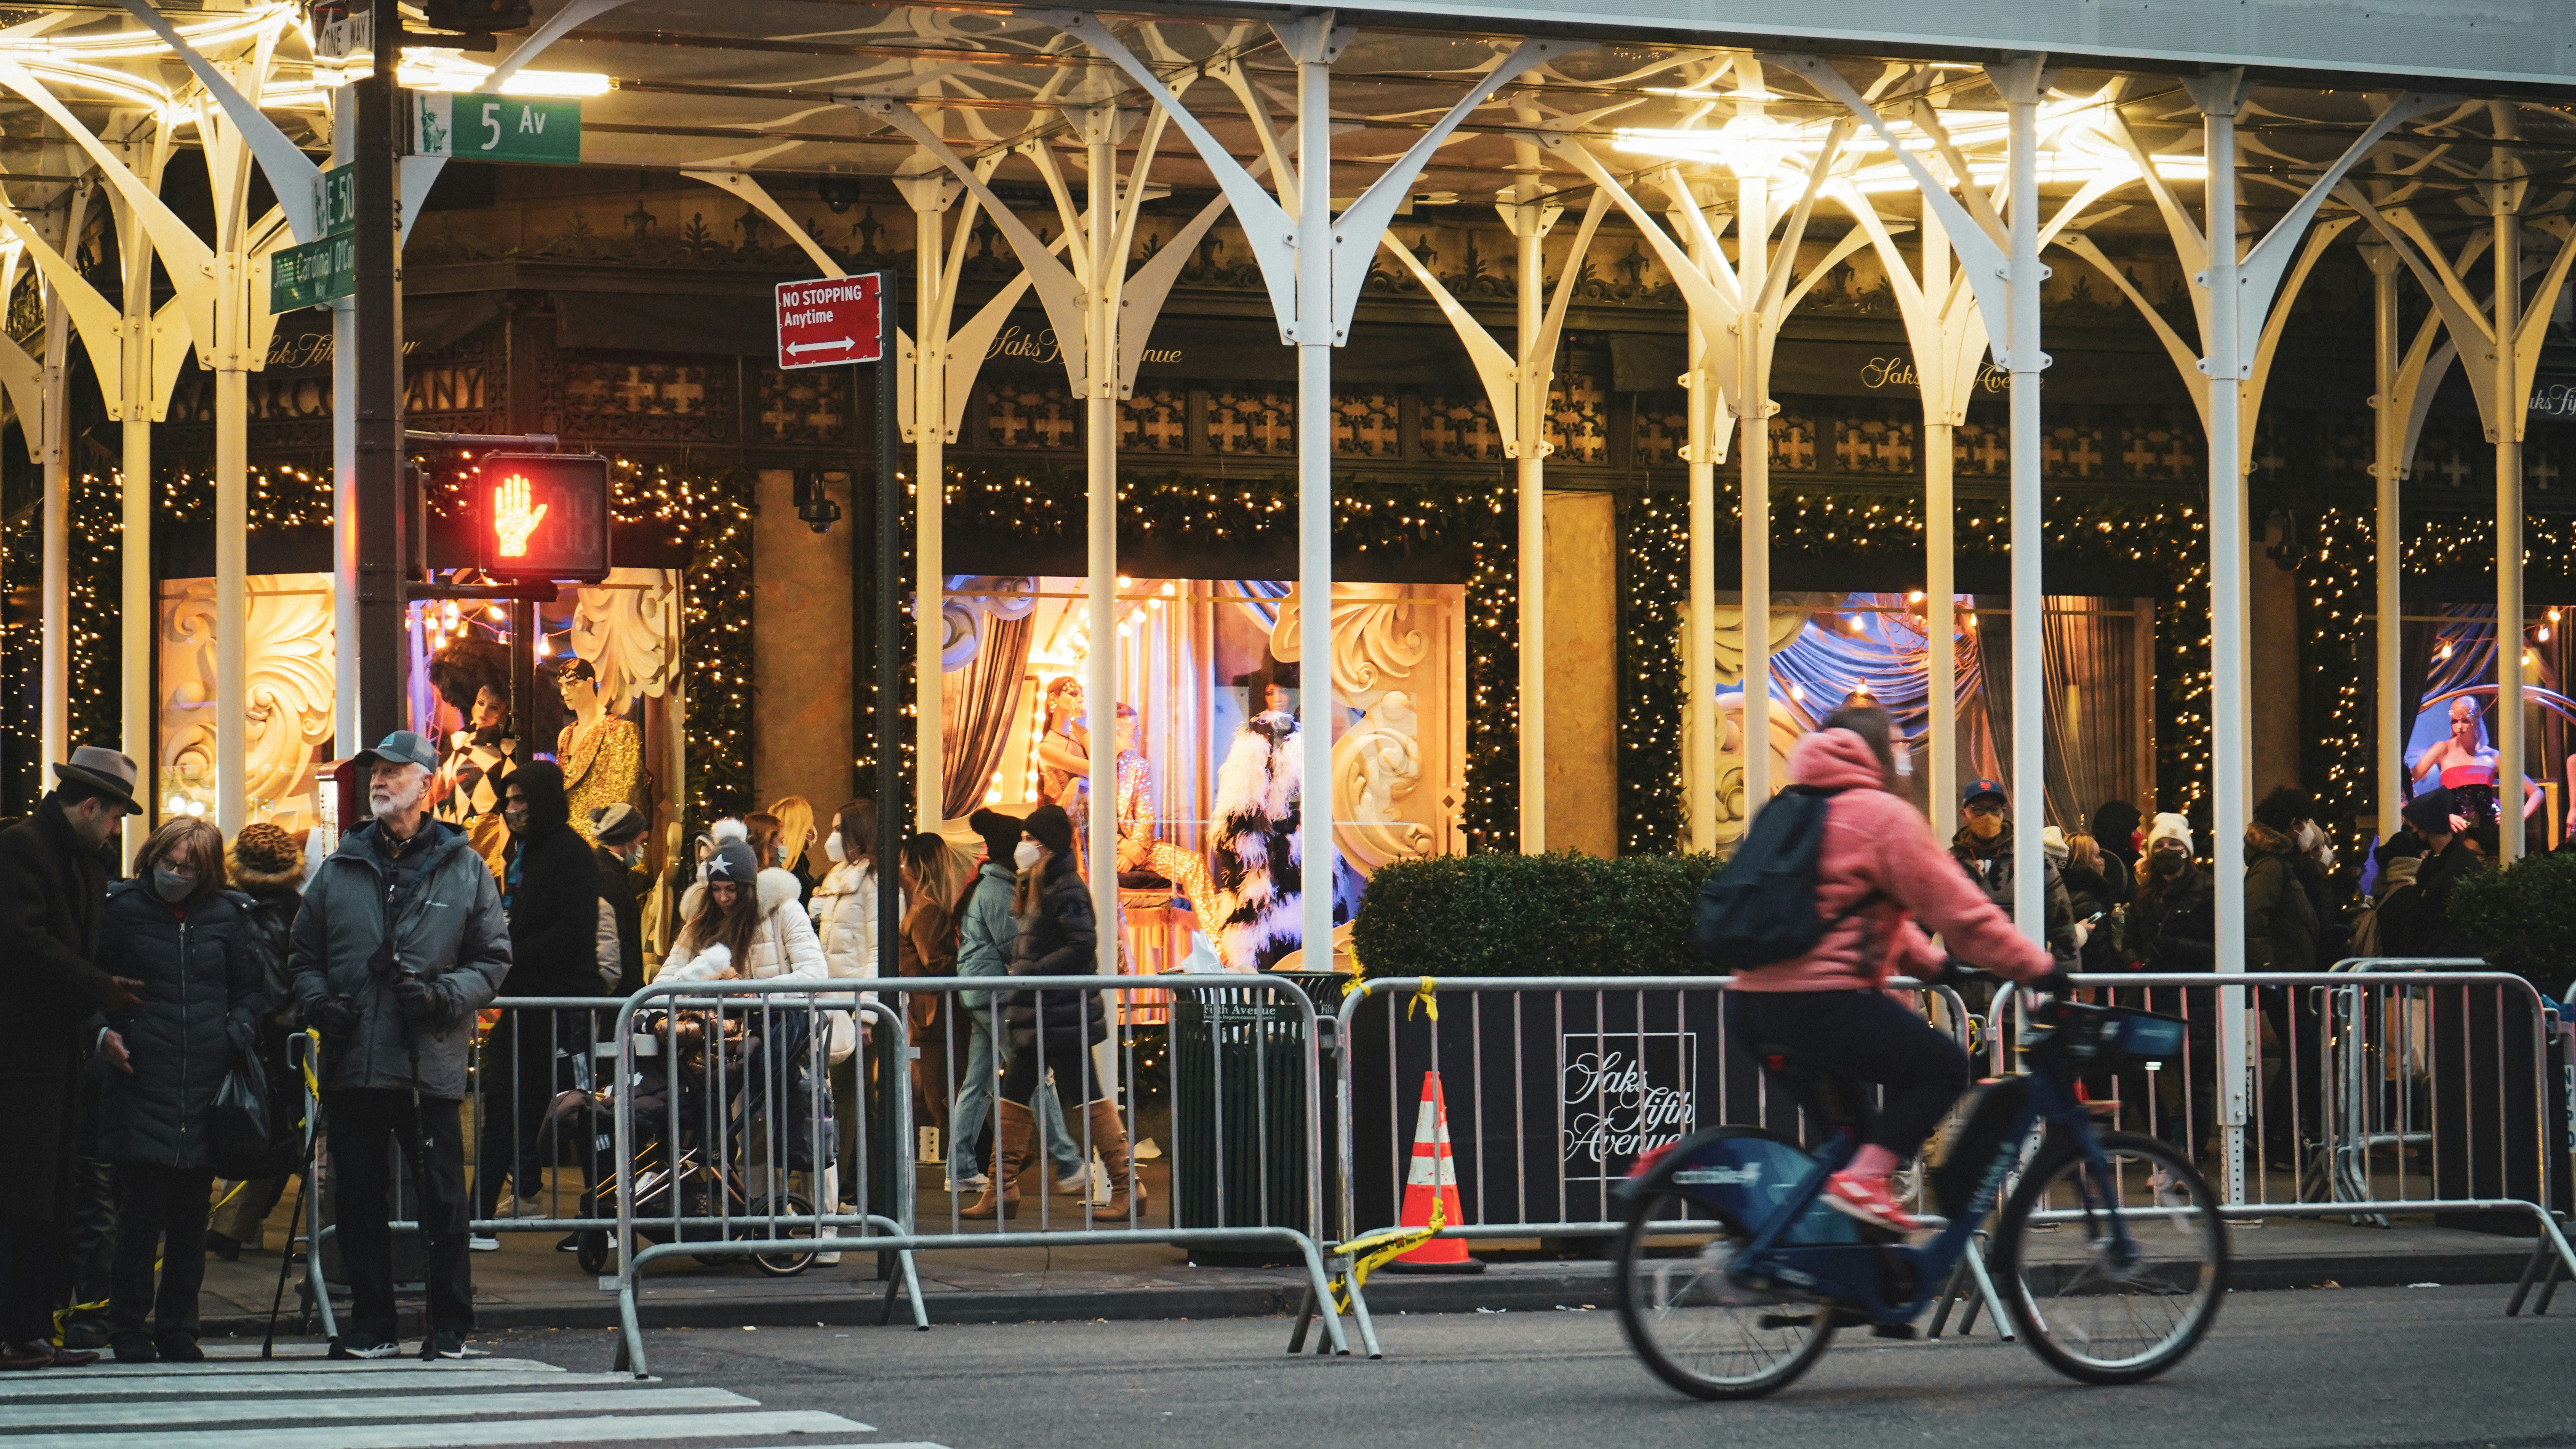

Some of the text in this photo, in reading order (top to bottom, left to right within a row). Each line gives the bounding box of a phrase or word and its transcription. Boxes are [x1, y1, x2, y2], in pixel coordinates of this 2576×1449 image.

[324, 15, 367, 57] ONE WAY
[480, 103, 546, 150] 5 Av
[327, 172, 355, 226] E 50
[782, 285, 862, 308] NO STOPPING
[784, 309, 834, 328] Anytime
[984, 325, 1041, 361] Saks
[1564, 1051, 1648, 1104] Saks
[1607, 1085, 1693, 1133] Fifth
